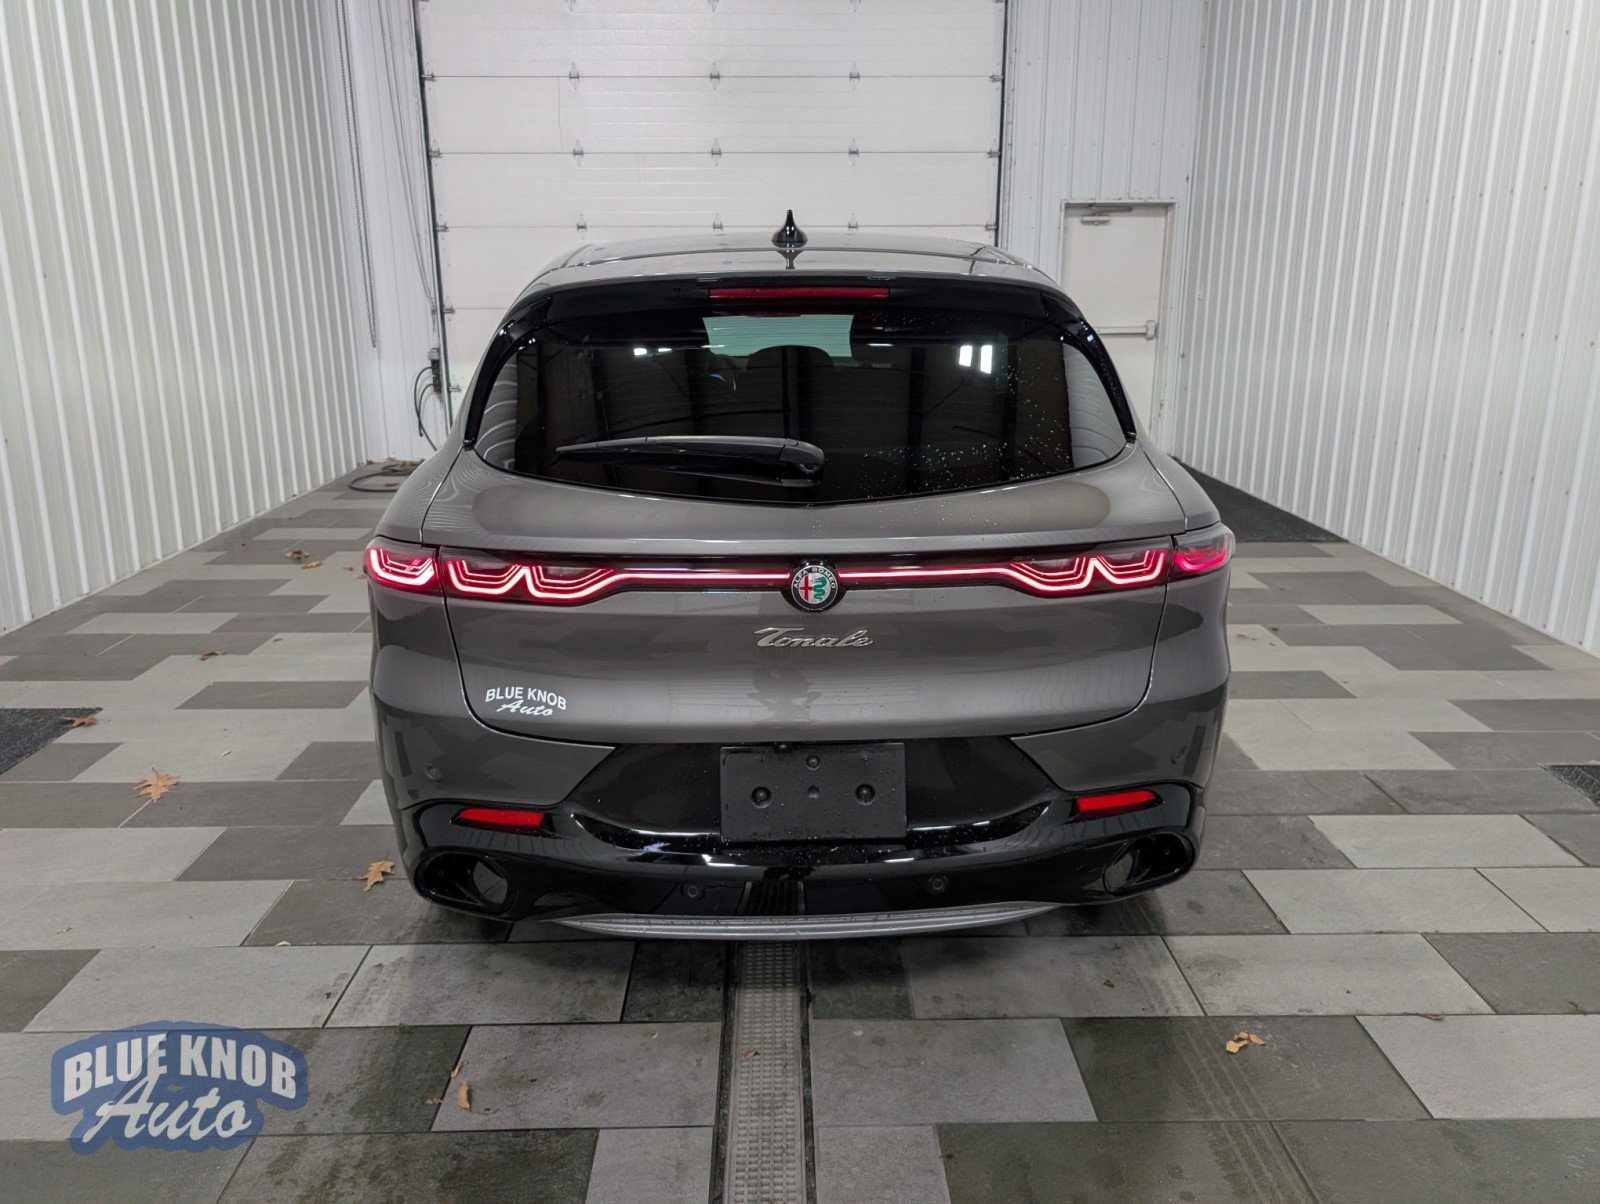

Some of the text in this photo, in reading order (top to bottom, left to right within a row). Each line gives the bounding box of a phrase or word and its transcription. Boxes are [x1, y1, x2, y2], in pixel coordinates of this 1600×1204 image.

[793, 567, 836, 589] ALFA ROMEO
[754, 627, 874, 647] Tonale
[485, 686, 567, 710] BLUE KNOB
[496, 699, 553, 716] Auto
